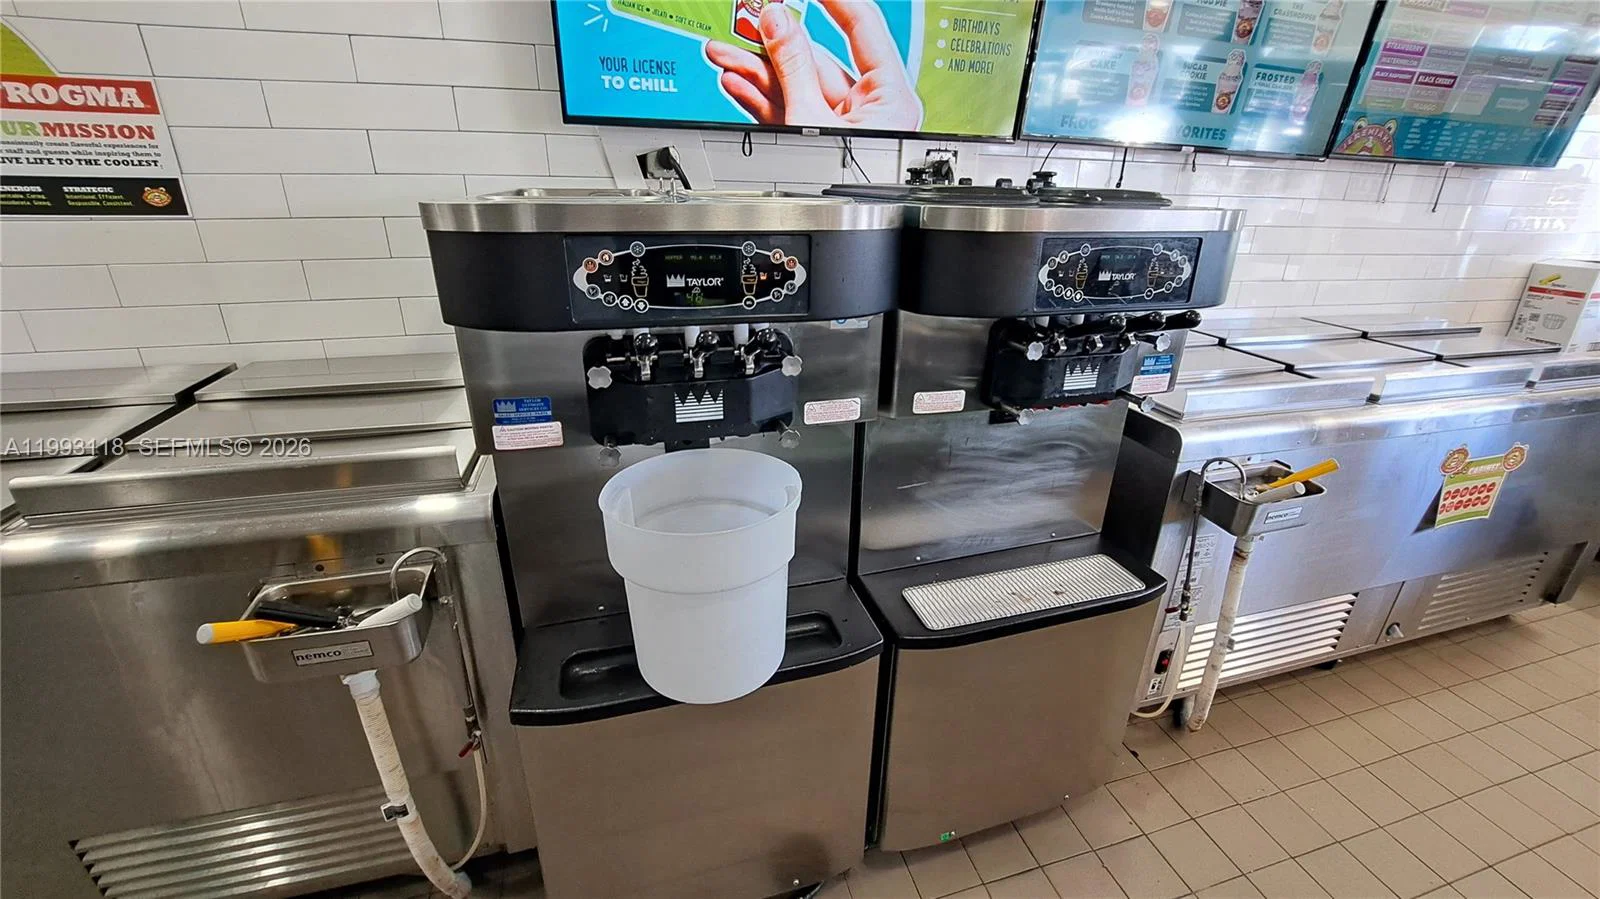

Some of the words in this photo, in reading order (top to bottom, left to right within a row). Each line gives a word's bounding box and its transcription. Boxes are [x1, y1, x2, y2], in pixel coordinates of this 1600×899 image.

[952, 18, 1001, 36] BIRTHDAYS
[950, 38, 1013, 57] CELEBRATIONS
[599, 56, 629, 73] YOUR
[633, 58, 677, 76] LICENSE
[947, 58, 966, 72] AND
[968, 60, 995, 75] MORE!
[601, 75, 625, 90] TO
[628, 77, 679, 93] CHILL
[1255, 71, 1296, 84] FROSTED
[0, 81, 145, 108] ROGMA
[25, 157, 55, 165] LIFE
[686, 277, 723, 287] TAYLOR
[296, 650, 342, 661] nemco
